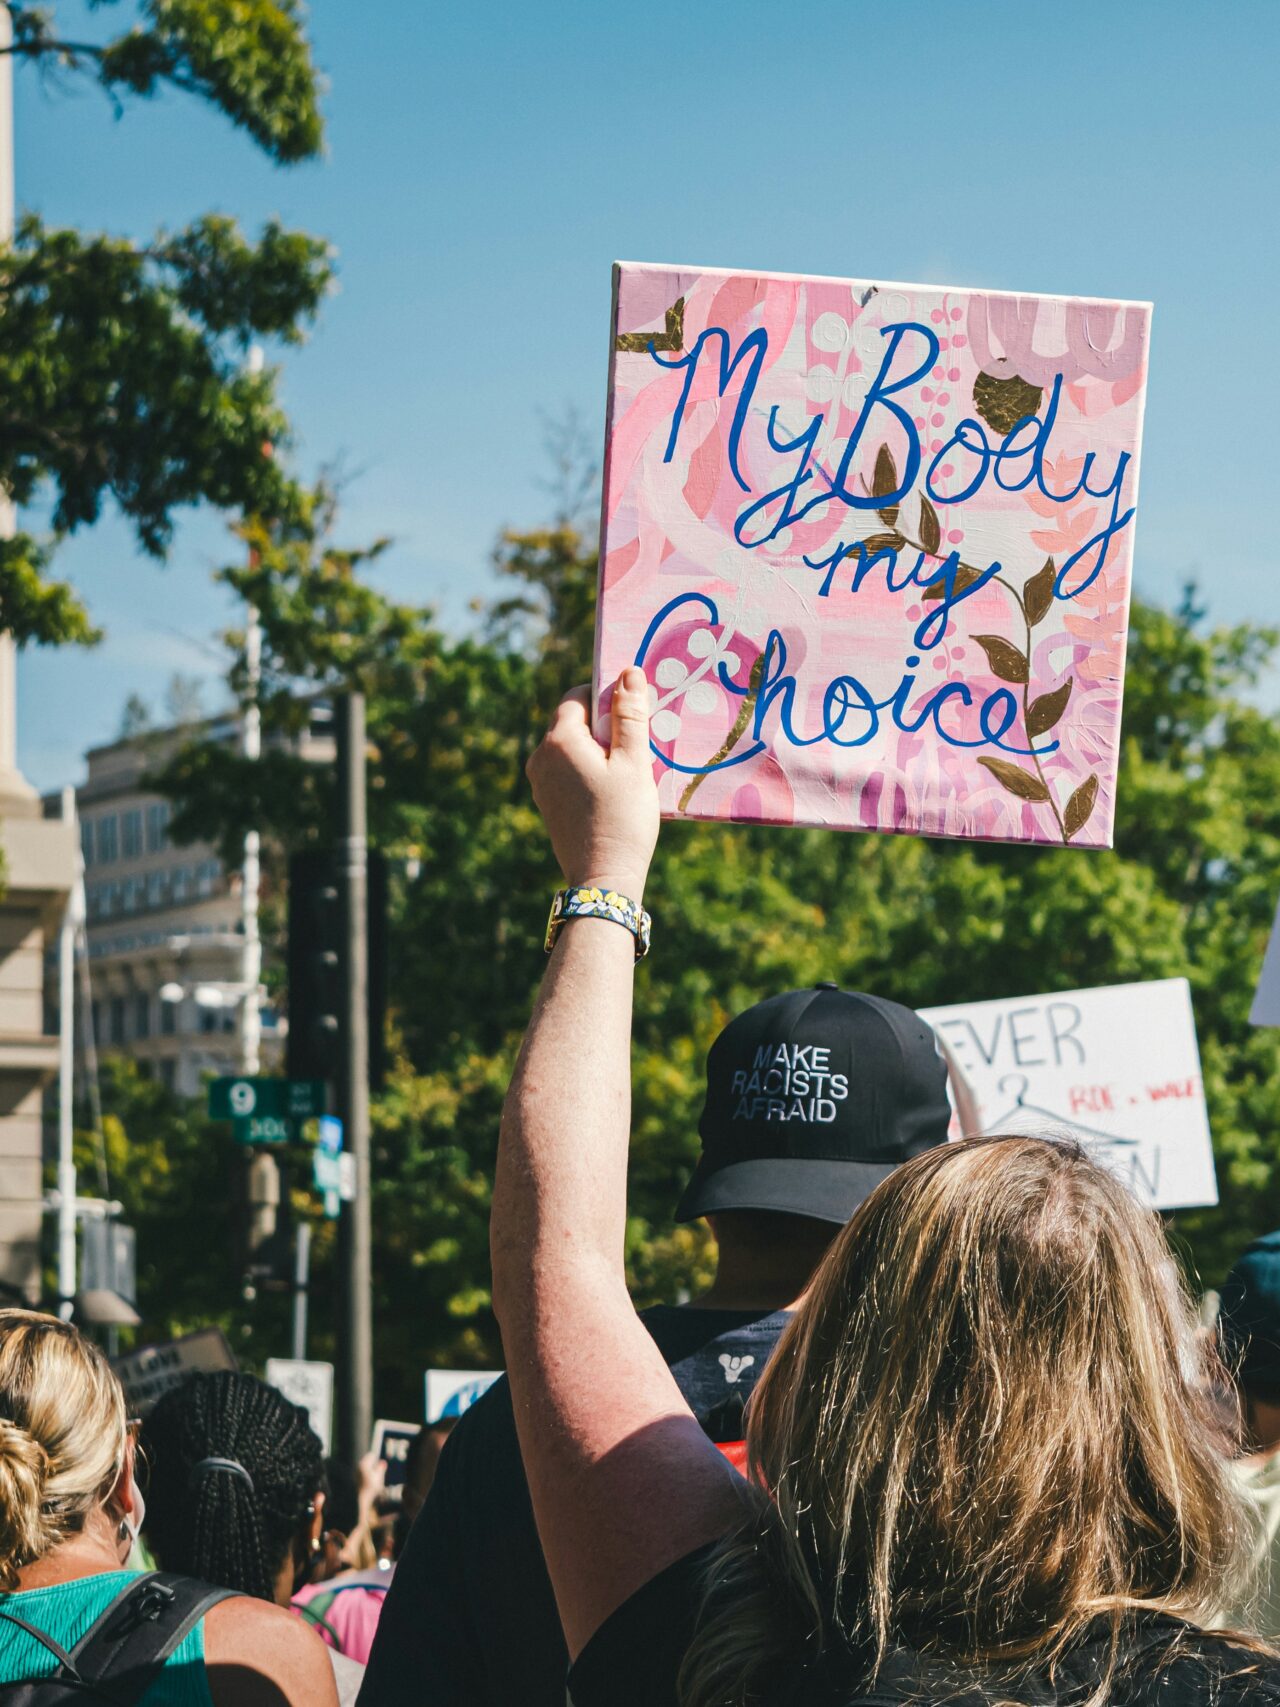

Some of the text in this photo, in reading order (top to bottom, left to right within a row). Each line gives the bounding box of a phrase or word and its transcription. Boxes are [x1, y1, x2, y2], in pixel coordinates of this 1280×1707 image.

[647, 321, 1136, 600] My Body
[803, 538, 1002, 650] my
[634, 592, 1060, 774] Choice
[752, 1043, 831, 1071] MAKE
[229, 1082, 257, 1115] 9
[731, 1070, 849, 1100] RACISTS
[733, 1098, 837, 1122] AFRAID
